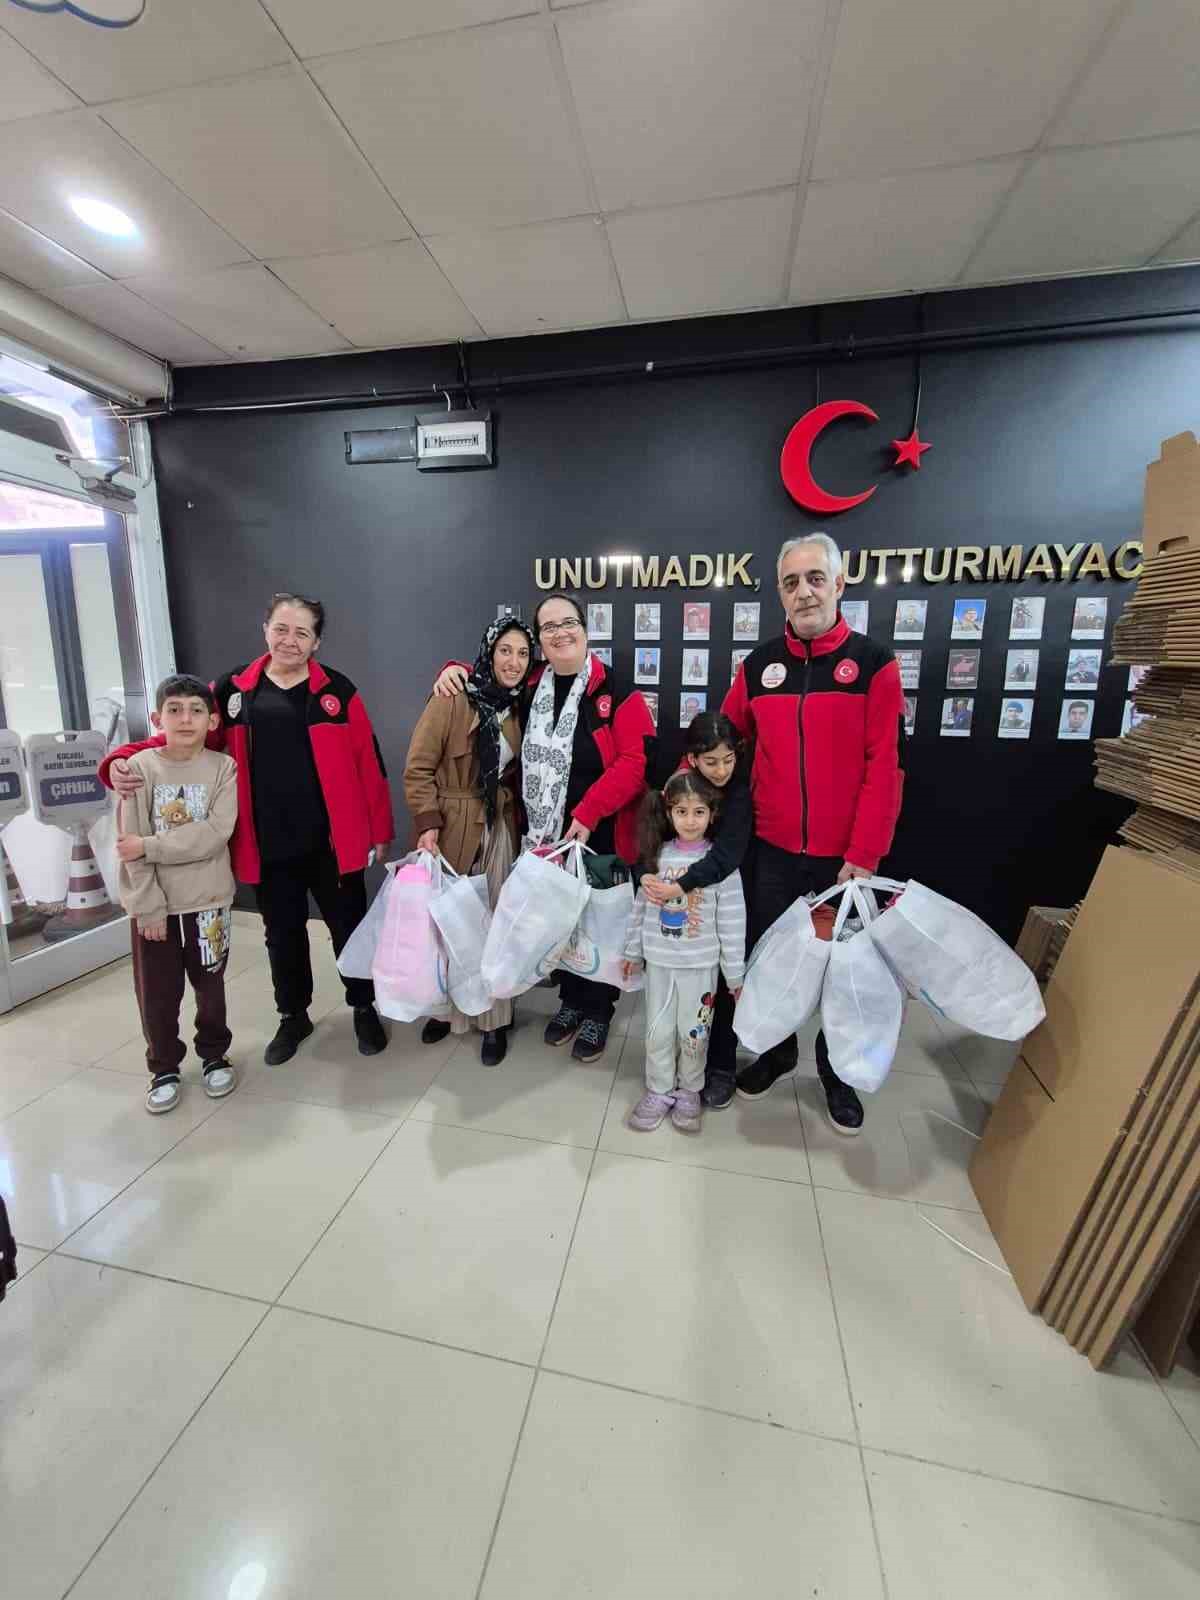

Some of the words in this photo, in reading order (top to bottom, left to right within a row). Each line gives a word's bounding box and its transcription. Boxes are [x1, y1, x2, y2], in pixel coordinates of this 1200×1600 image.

[535, 553, 760, 591] UNUTMADIK,
[842, 541, 1144, 585] UTTURMAYAC
[50, 780, 97, 800] Çiftlik
